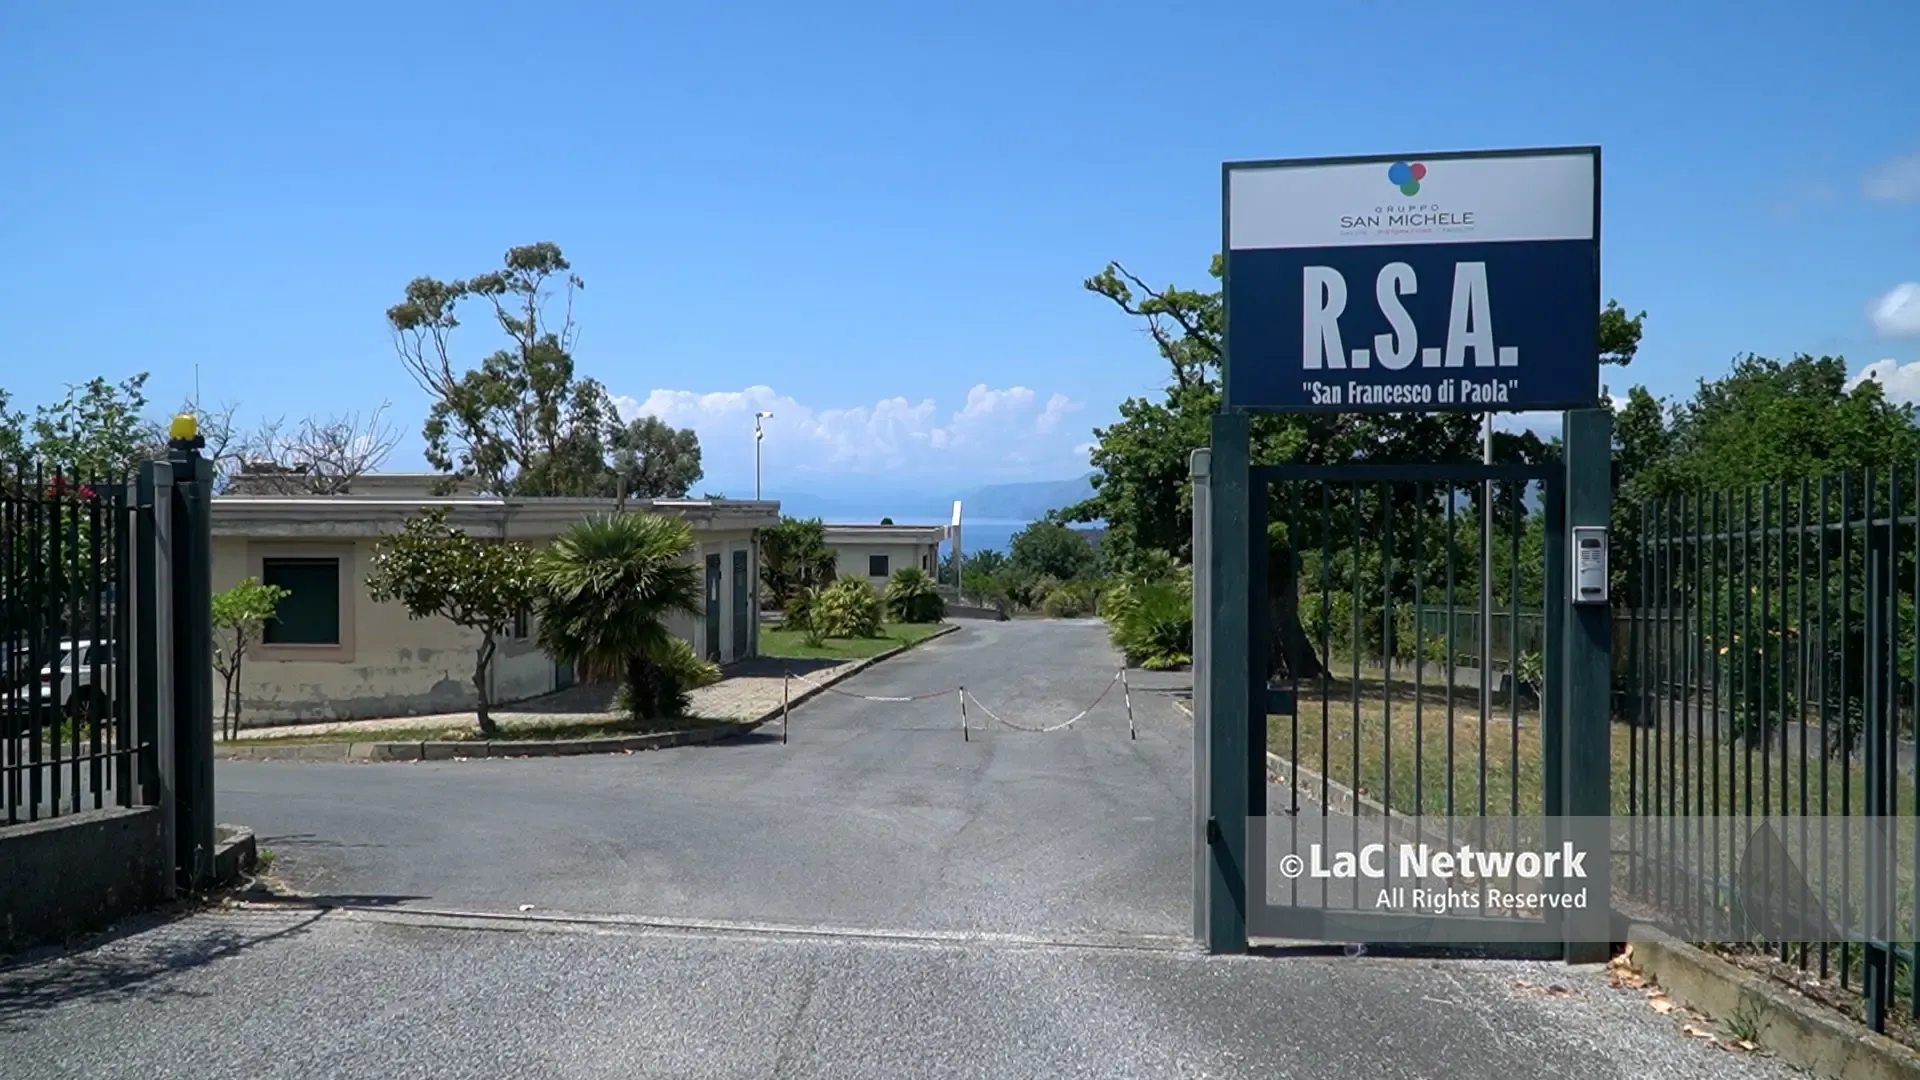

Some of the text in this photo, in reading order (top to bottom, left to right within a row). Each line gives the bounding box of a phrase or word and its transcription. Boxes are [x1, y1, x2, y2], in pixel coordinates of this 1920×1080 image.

[1374, 203, 1440, 214] GRUPPO
[1340, 211, 1475, 229] SAN MICHELE
[1302, 261, 1519, 371] R.S.A.
[1302, 378, 1519, 405] "San Francesco di Paola"
